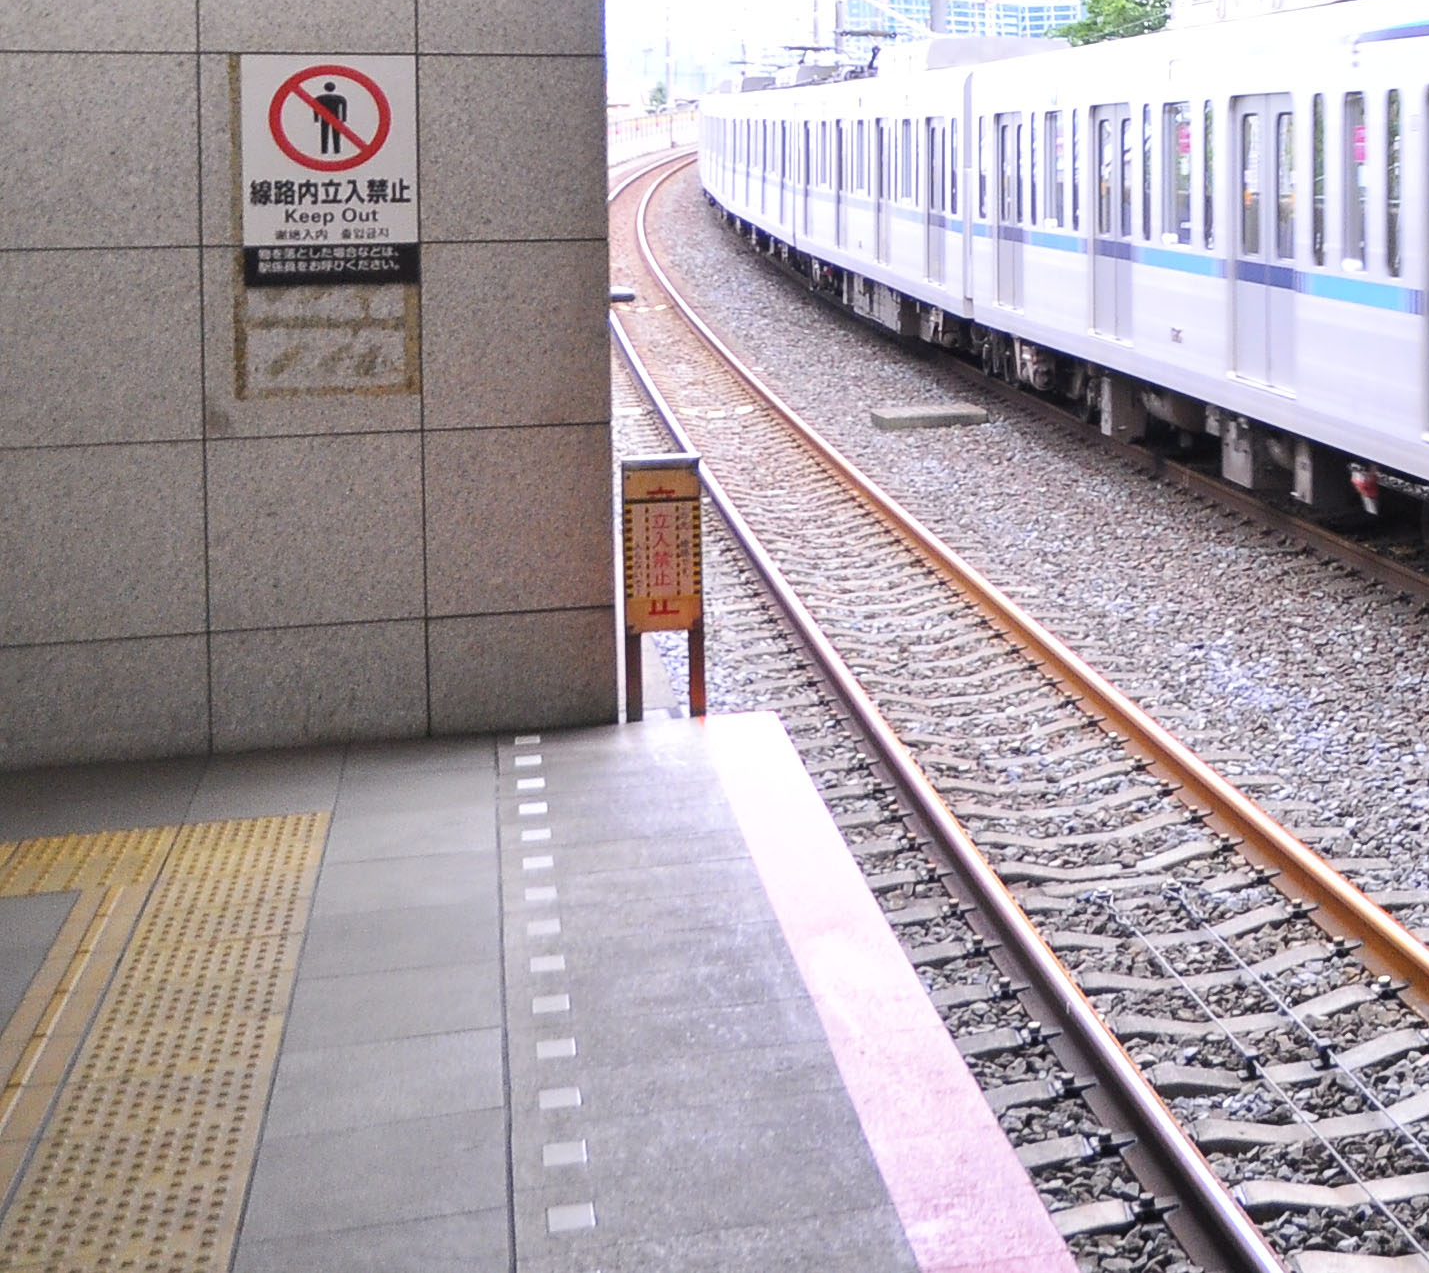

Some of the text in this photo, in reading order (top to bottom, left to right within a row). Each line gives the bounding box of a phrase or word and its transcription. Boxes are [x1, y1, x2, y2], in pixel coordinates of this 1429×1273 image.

[250, 178, 411, 206] 線路内立入禁止
[285, 207, 379, 226] Keep Out
[652, 513, 673, 587] 立入禁止
